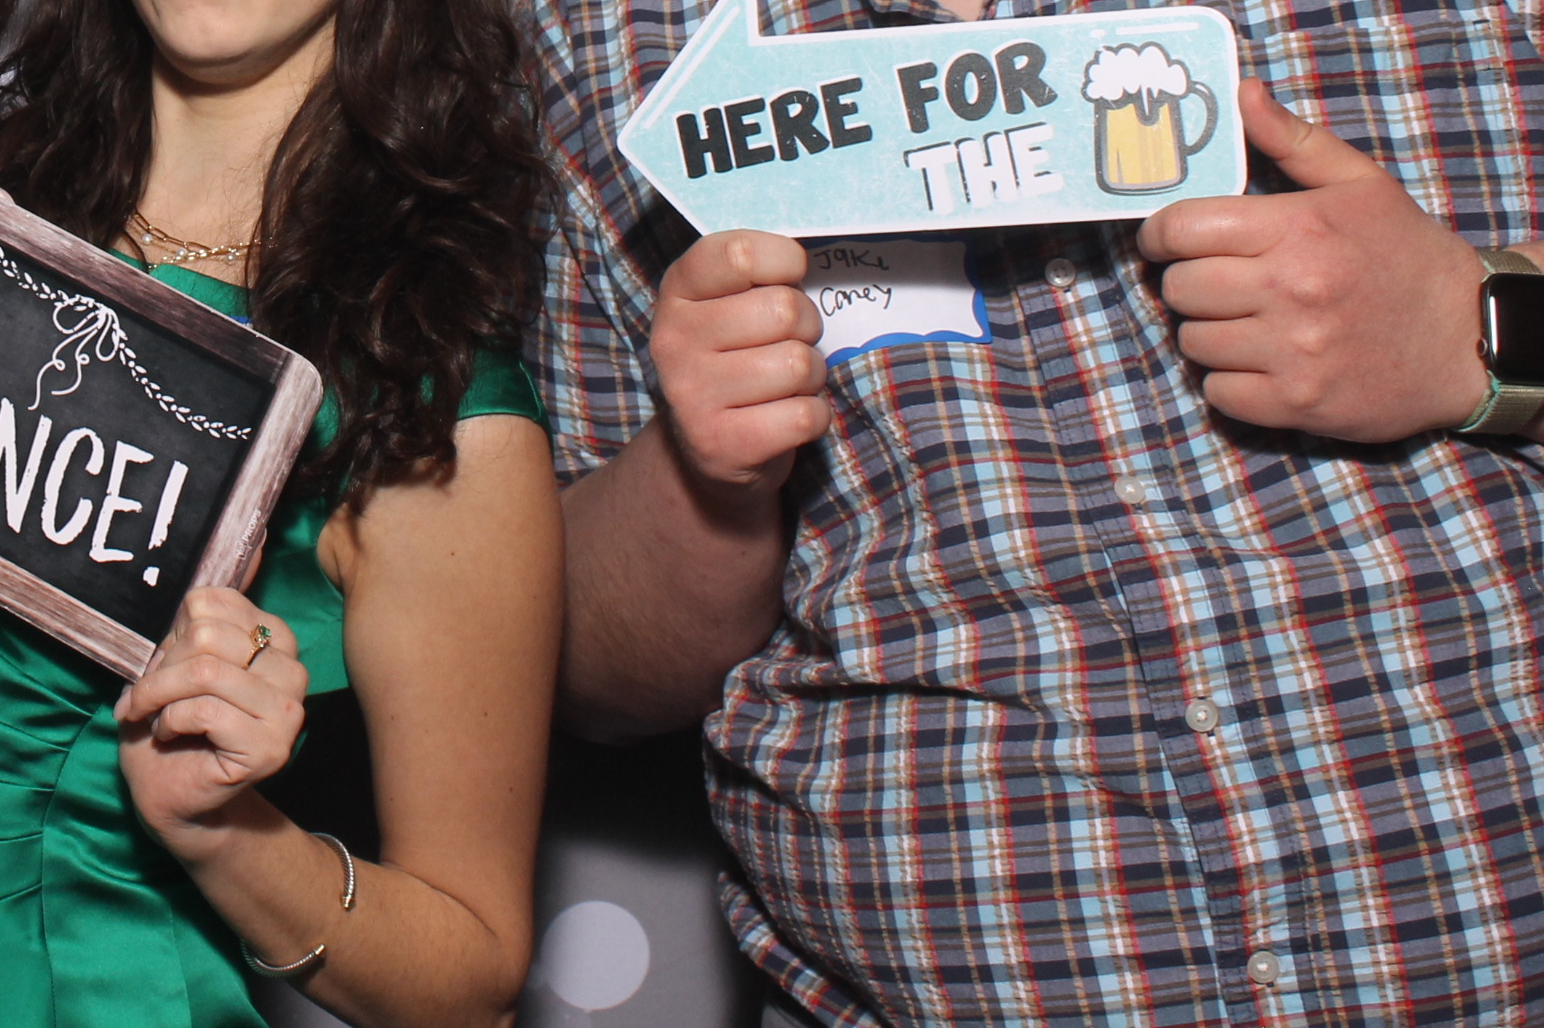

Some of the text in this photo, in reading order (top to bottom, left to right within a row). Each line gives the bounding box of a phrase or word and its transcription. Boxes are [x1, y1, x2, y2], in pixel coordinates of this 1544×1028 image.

[676, 42, 1057, 178] HERE FOR
[903, 122, 1064, 215] THE
[242, 507, 261, 542] PROPS
